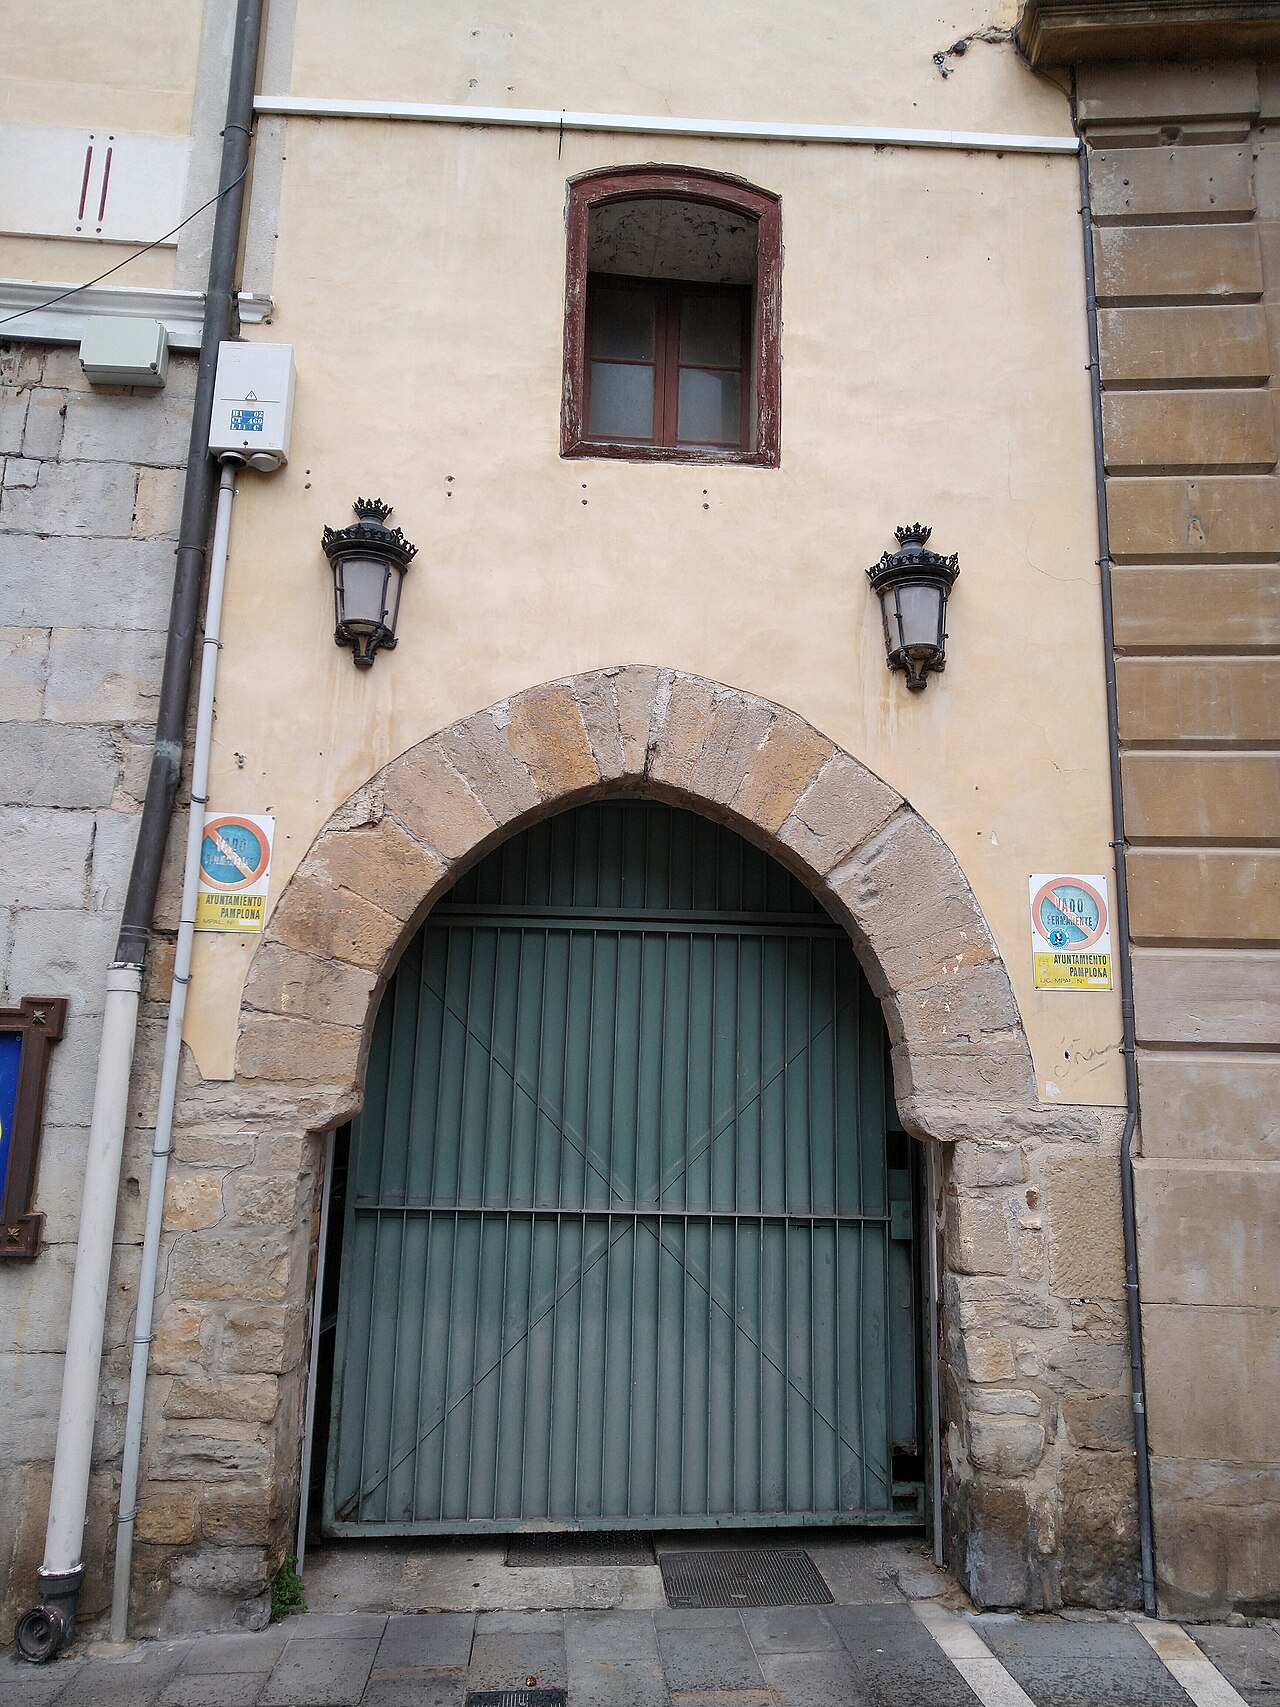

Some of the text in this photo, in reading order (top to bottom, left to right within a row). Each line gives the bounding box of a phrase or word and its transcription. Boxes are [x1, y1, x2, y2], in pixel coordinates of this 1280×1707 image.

[205, 894, 262, 907] AYUNTAMIENTO
[1055, 897, 1084, 914] VADO
[220, 907, 260, 920] PAMPLONA
[1053, 954, 1107, 965] AYUNTAMIENTO
[1069, 966, 1108, 978] PAMPLONA
